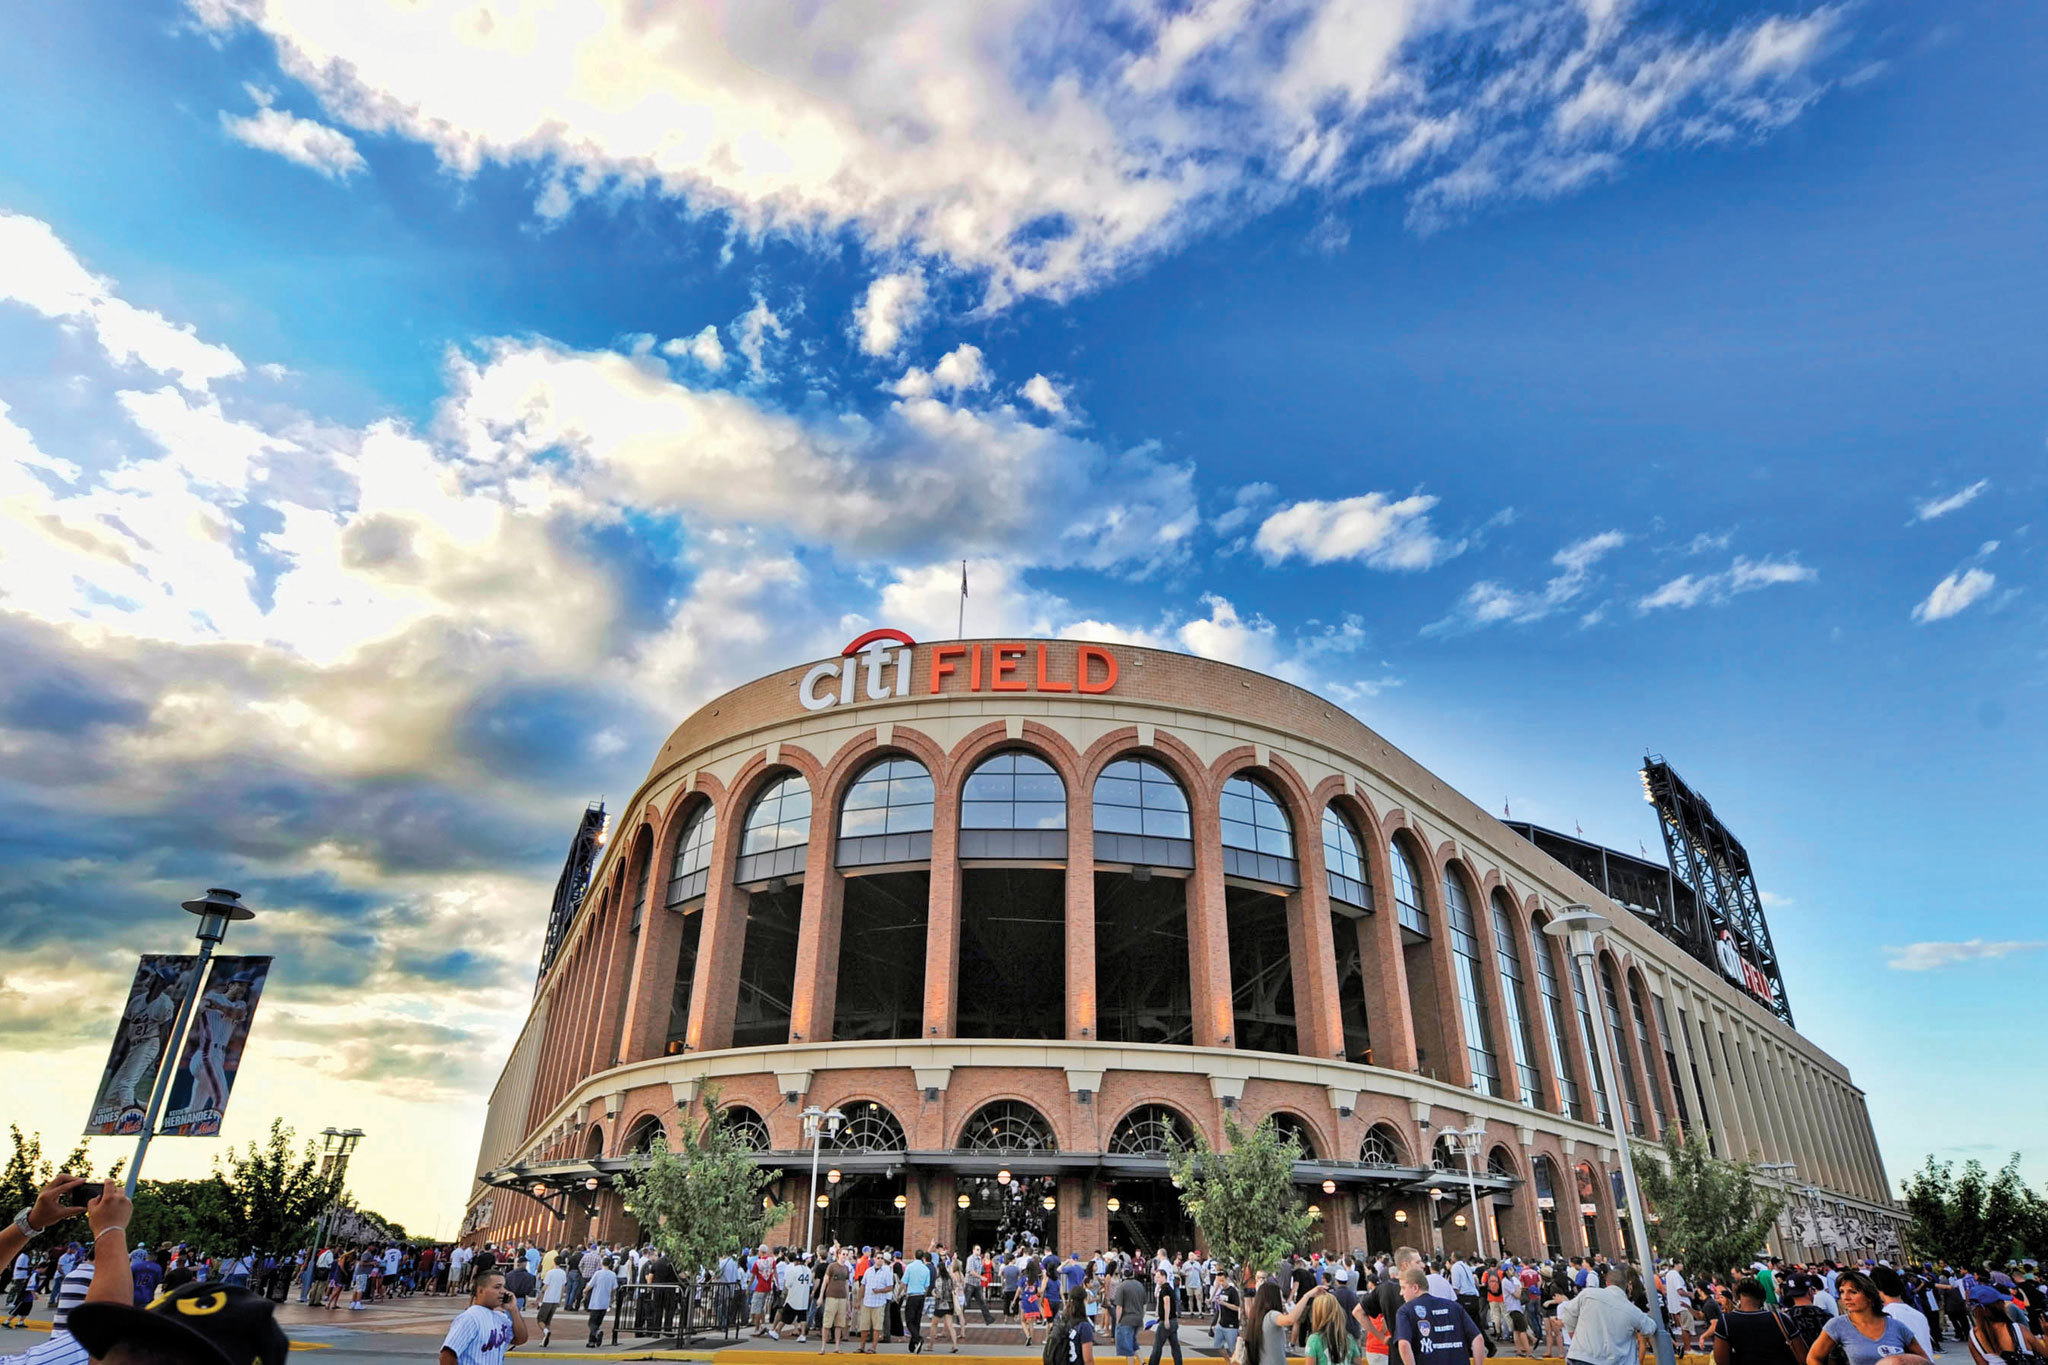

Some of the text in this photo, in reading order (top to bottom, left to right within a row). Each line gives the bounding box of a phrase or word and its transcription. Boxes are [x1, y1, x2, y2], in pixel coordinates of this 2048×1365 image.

[799, 641, 1118, 711] citi FIELD
[92, 1110, 119, 1126] JONES
[164, 1110, 213, 1128] HERNANDEZ
[797, 1273, 810, 1285] 44
[481, 1323, 507, 1353] Met
